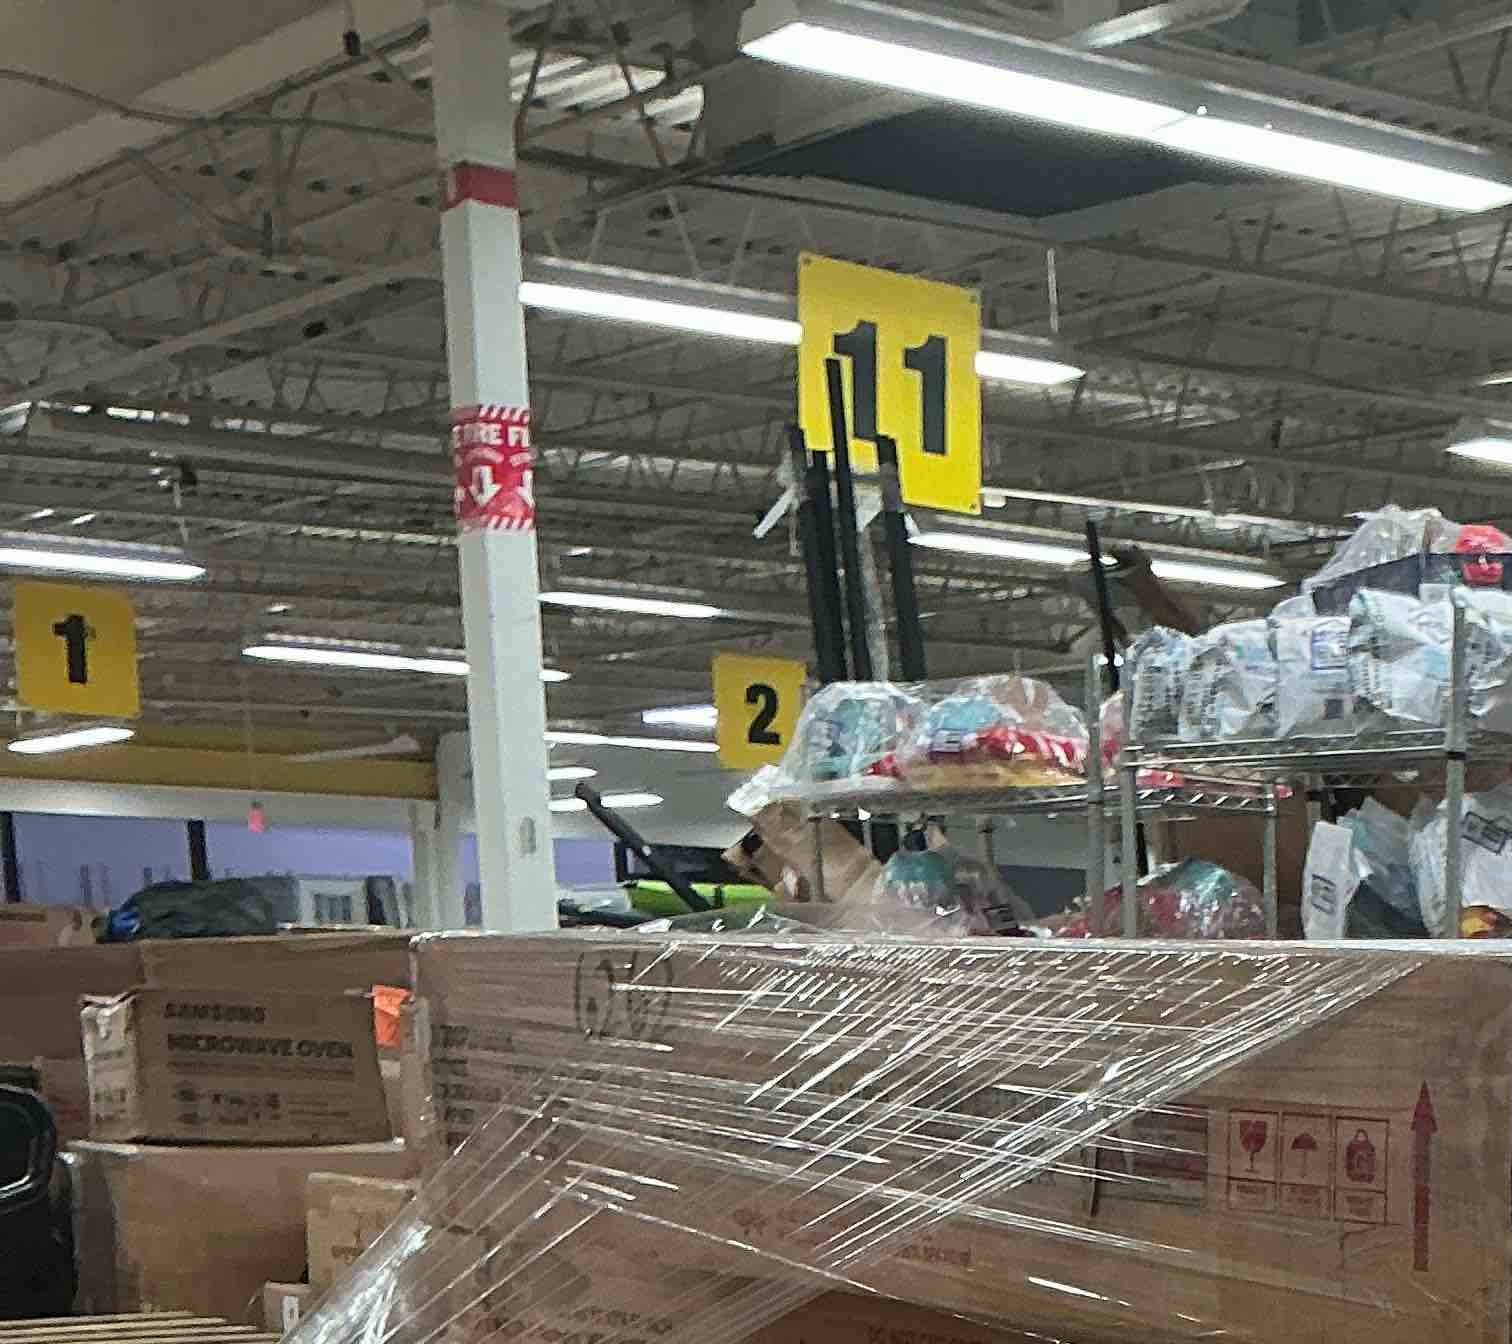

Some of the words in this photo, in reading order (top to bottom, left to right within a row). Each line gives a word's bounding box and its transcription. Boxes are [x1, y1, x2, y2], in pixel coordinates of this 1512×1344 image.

[833, 320, 948, 455] 11
[52, 613, 91, 684] 1
[745, 683, 780, 745] 2
